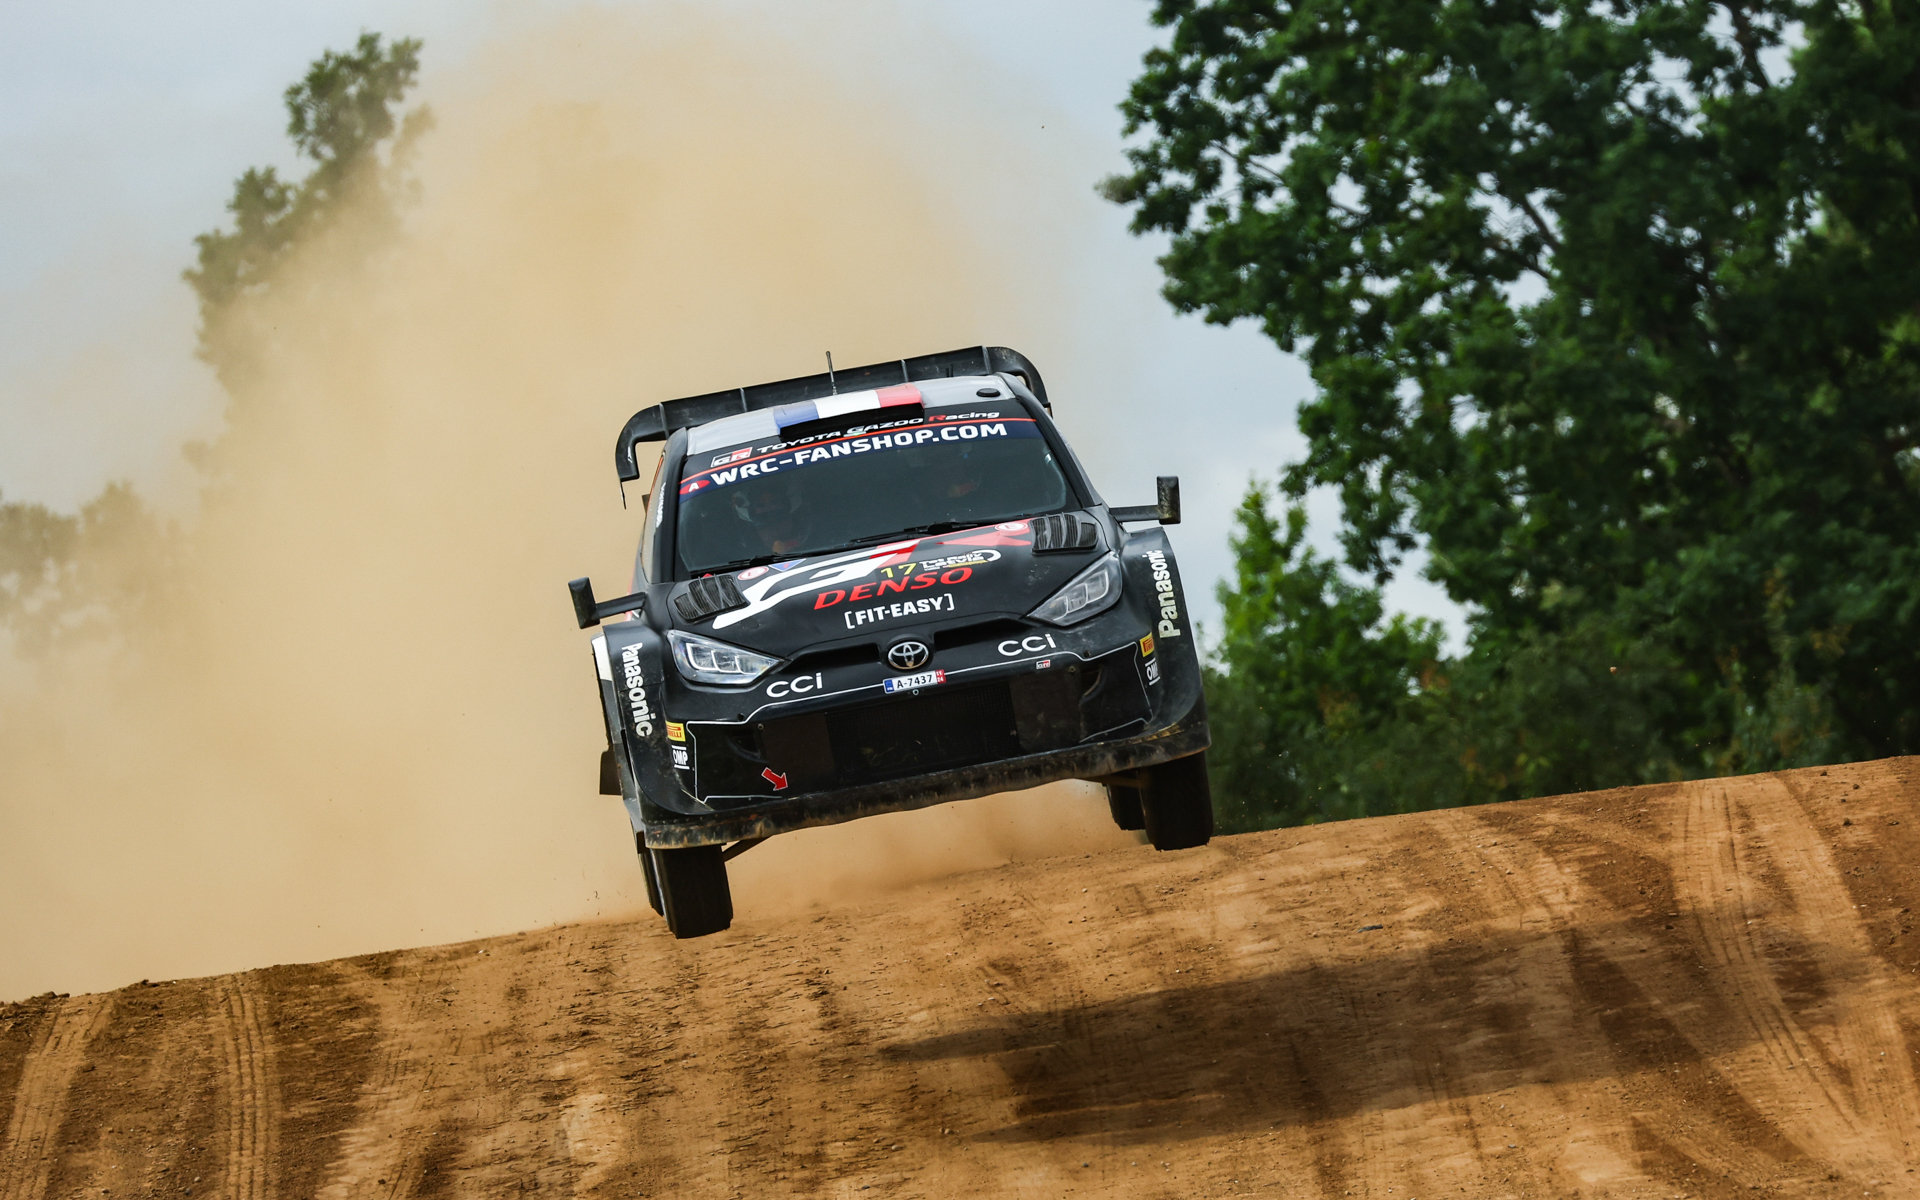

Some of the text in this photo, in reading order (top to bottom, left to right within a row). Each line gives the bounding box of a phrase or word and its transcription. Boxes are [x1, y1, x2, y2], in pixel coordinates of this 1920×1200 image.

[688, 423, 1008, 492] A WRC-FANSHOP.COM
[713, 412, 1000, 466] GR TOYOTA GAZOO Racing
[814, 567, 973, 610] DENSO
[881, 562, 917, 578] 17
[1142, 550, 1181, 638] Panasonic
[621, 642, 656, 737] Panasonic
[896, 674, 933, 690] A-7437
[672, 749, 688, 765] OMP
